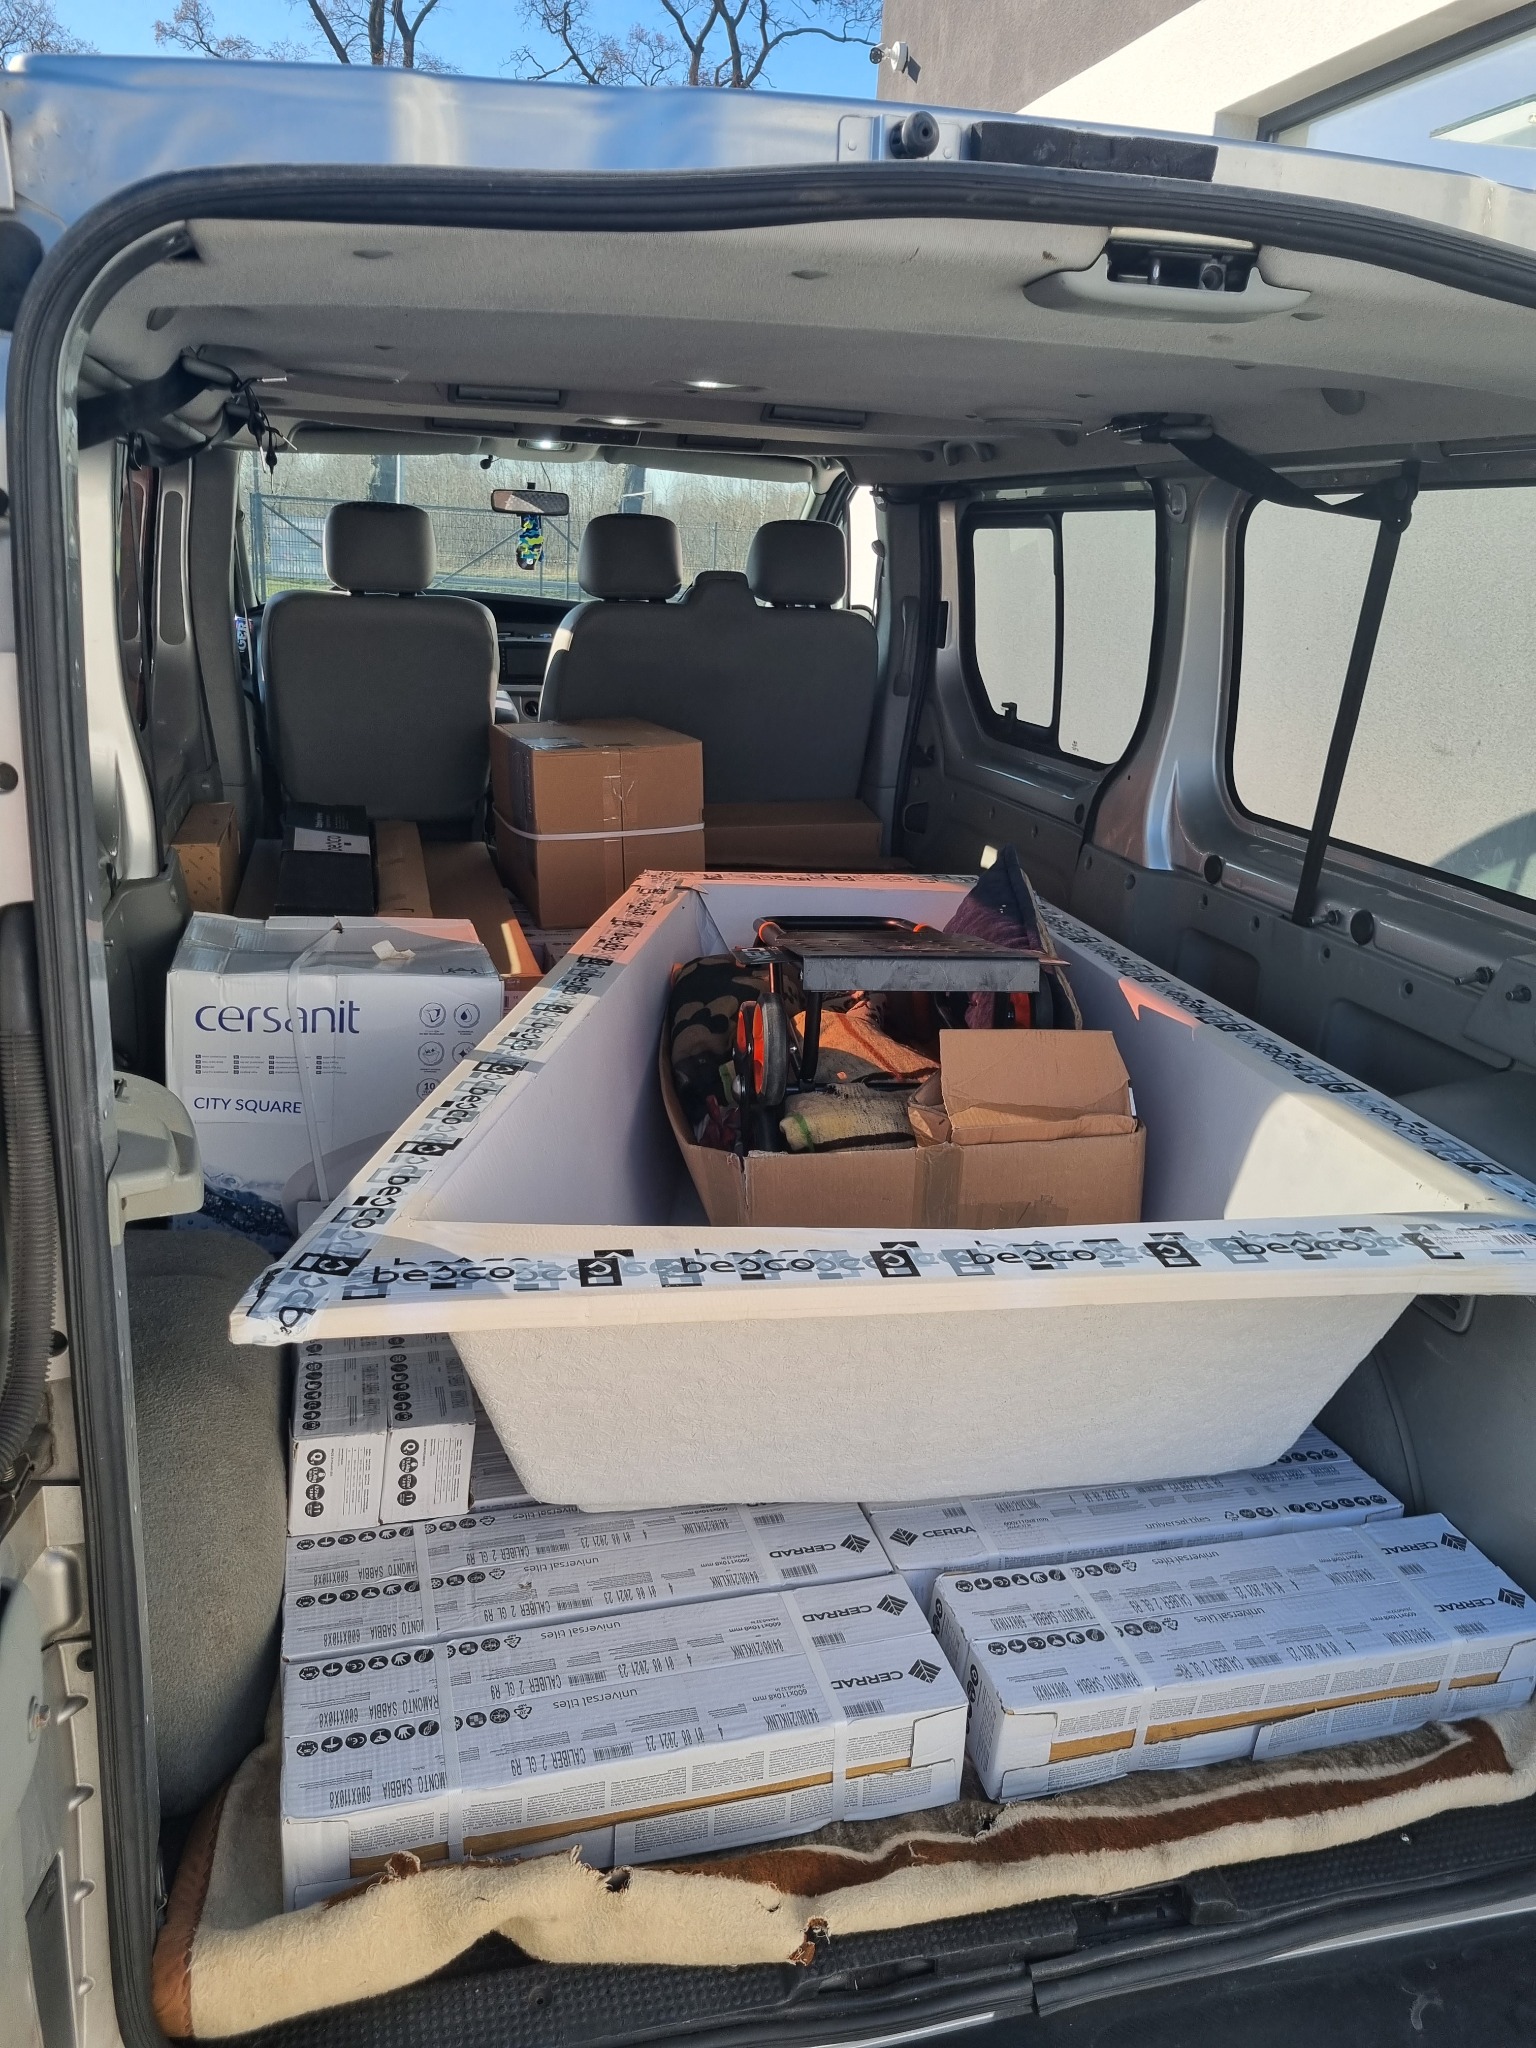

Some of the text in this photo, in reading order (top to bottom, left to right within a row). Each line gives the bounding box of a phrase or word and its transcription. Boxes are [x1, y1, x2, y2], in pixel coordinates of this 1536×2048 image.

[195, 1000, 361, 1034] cersanit
[424, 1082, 435, 1090] 10
[193, 1097, 303, 1114] CITY SQUARE
[441, 1086, 498, 1125] besco
[351, 1175, 421, 1229] besco
[965, 1248, 1097, 1265] besco
[681, 1257, 815, 1274] besco
[373, 1265, 515, 1285] besco
[512, 1512, 536, 1520] tiles
[1145, 1517, 1189, 1529] universal
[922, 1526, 976, 1538] CERRA
[580, 1538, 588, 1549] 23
[592, 1534, 607, 1547] 2021
[1381, 1540, 1438, 1555] CERRAD
[478, 1551, 488, 1563] GL
[492, 1550, 496, 1561] 2
[501, 1546, 530, 1560] CALIBER
[769, 1543, 836, 1559] CERRAD
[1151, 1551, 1219, 1566] universal tiles
[466, 1554, 475, 1565] R9
[523, 1557, 599, 1574] universal tiles
[358, 1567, 383, 1582] SABBIA
[615, 1588, 632, 1603] 2021
[635, 1587, 644, 1599] 08
[647, 1585, 656, 1598] 01
[668, 1583, 674, 1594] 4
[603, 1592, 612, 1604] 23
[1434, 1597, 1495, 1613] CERRAD
[484, 1609, 493, 1622] R9
[497, 1606, 507, 1619] GL
[510, 1605, 516, 1618] 2
[520, 1600, 551, 1616] CALIBER
[802, 1605, 872, 1622] CERRAD
[1194, 1607, 1265, 1624] universal tiles
[1032, 1610, 1058, 1627] SABBIA
[323, 1629, 360, 1647] 600X110X8
[370, 1624, 397, 1640] SABBIA
[540, 1621, 621, 1640] universal tiles
[630, 1659, 648, 1676] 2021
[652, 1658, 662, 1672] 08
[664, 1656, 674, 1670] 01
[686, 1653, 692, 1667] 4
[617, 1663, 628, 1678] 23
[519, 1680, 525, 1695] 2
[528, 1674, 562, 1693] CALIBER
[830, 1671, 903, 1690] CERRAD
[1073, 1676, 1104, 1695] SABBIA
[490, 1684, 500, 1700] R9
[504, 1681, 515, 1697] GL
[768, 1688, 808, 1699] 600x110x8
[402, 1694, 439, 1716] RAMONTO
[552, 1688, 638, 1710] universal tiles
[319, 1707, 359, 1728] 600X110X8
[368, 1699, 397, 1720] SABBIA
[681, 1729, 691, 1745] 08
[695, 1727, 705, 1742] 01
[717, 1724, 724, 1739] 4
[645, 1735, 654, 1751] 23
[658, 1731, 677, 1749] 2021
[526, 1756, 537, 1773] GL
[540, 1754, 548, 1771] 2
[551, 1748, 586, 1769] CALIBER
[510, 1759, 522, 1776] R9
[382, 1777, 412, 1799] SABBIA
[418, 1772, 445, 1795] MONTO
[329, 1785, 371, 1809] 600X110X8
